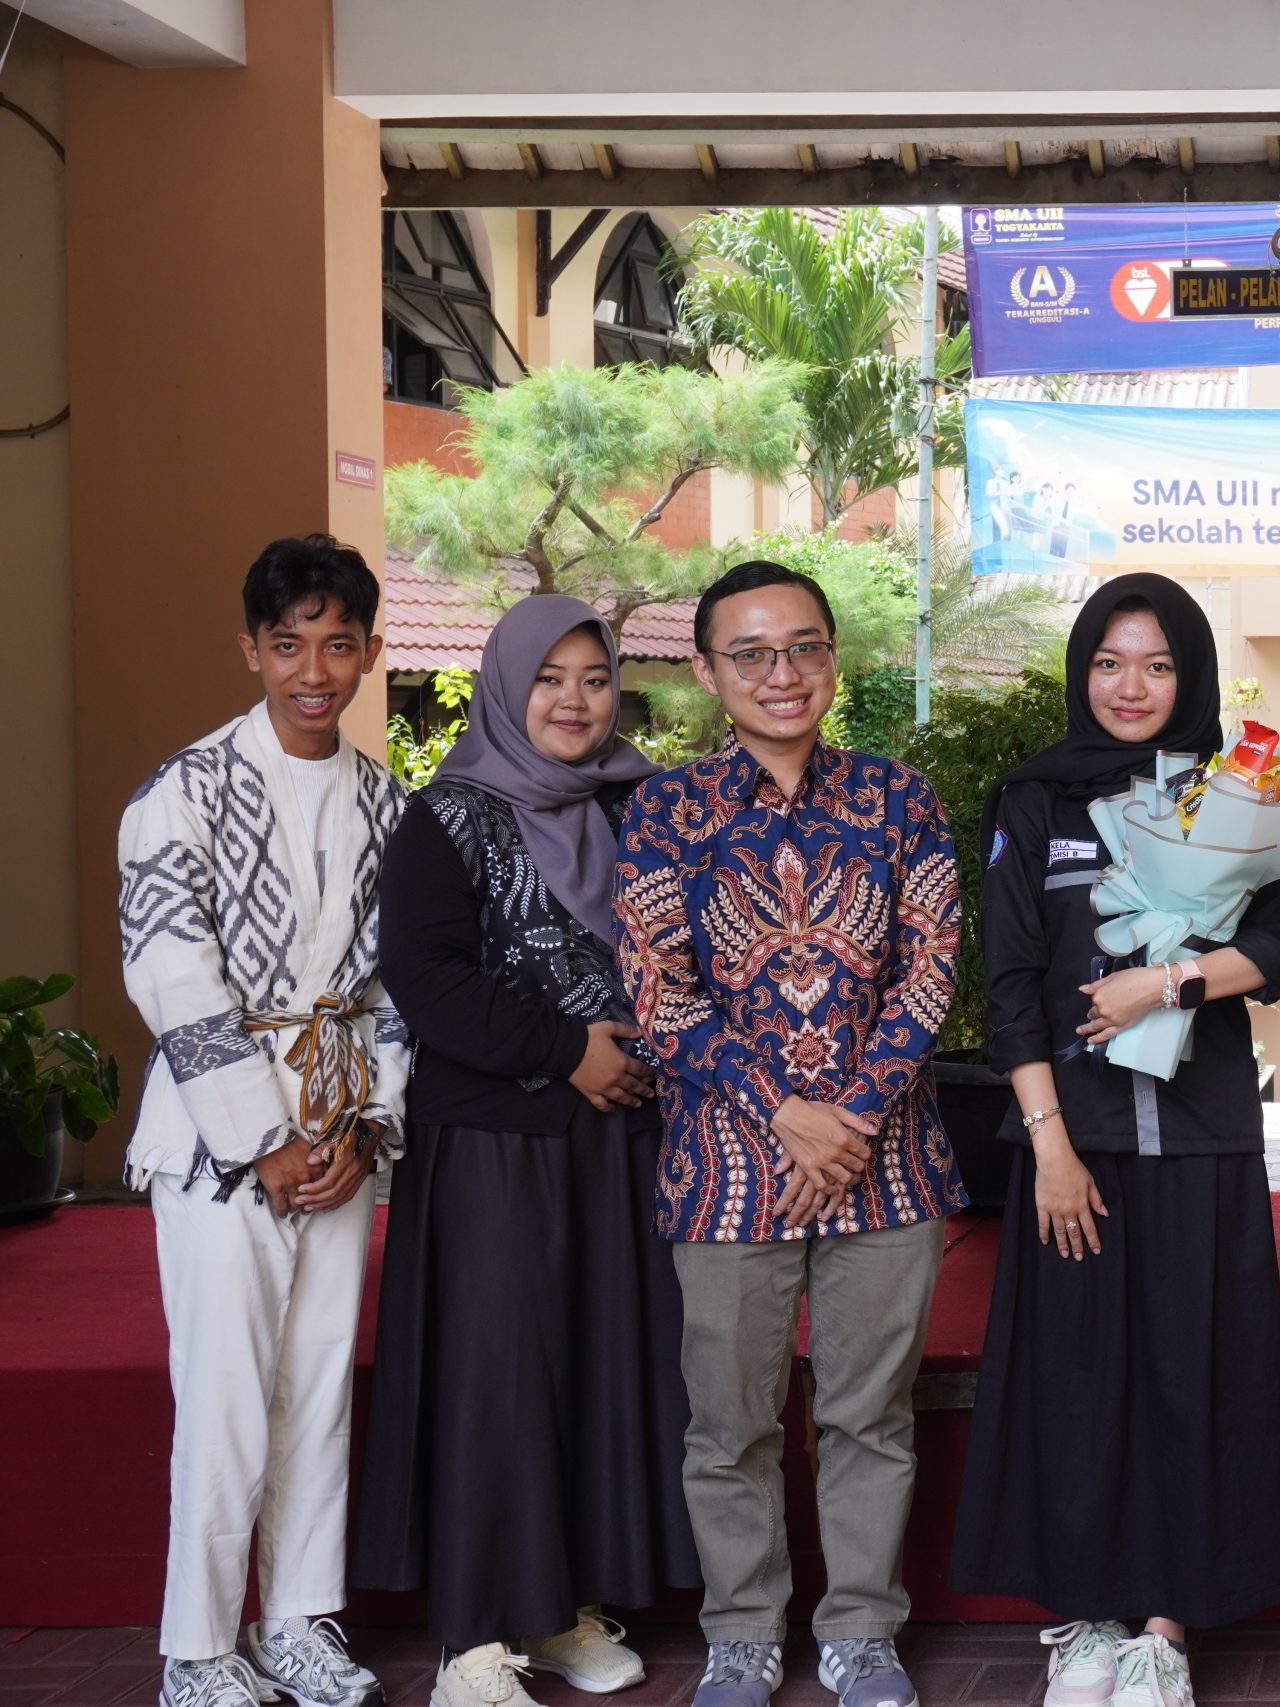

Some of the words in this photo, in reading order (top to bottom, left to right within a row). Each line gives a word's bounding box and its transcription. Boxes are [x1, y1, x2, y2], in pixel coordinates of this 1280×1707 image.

[994, 208, 1033, 221] SMA
[1036, 206, 1064, 220] UII
[994, 222, 1065, 232] YOGYAKARTA
[1029, 265, 1058, 298] A
[1179, 278, 1227, 309] PELAN
[1005, 308, 1091, 319] TERAKREDITASI-A
[1132, 479, 1206, 507] SMA
[1217, 480, 1259, 507] UII
[1122, 517, 1243, 545] sekolah
